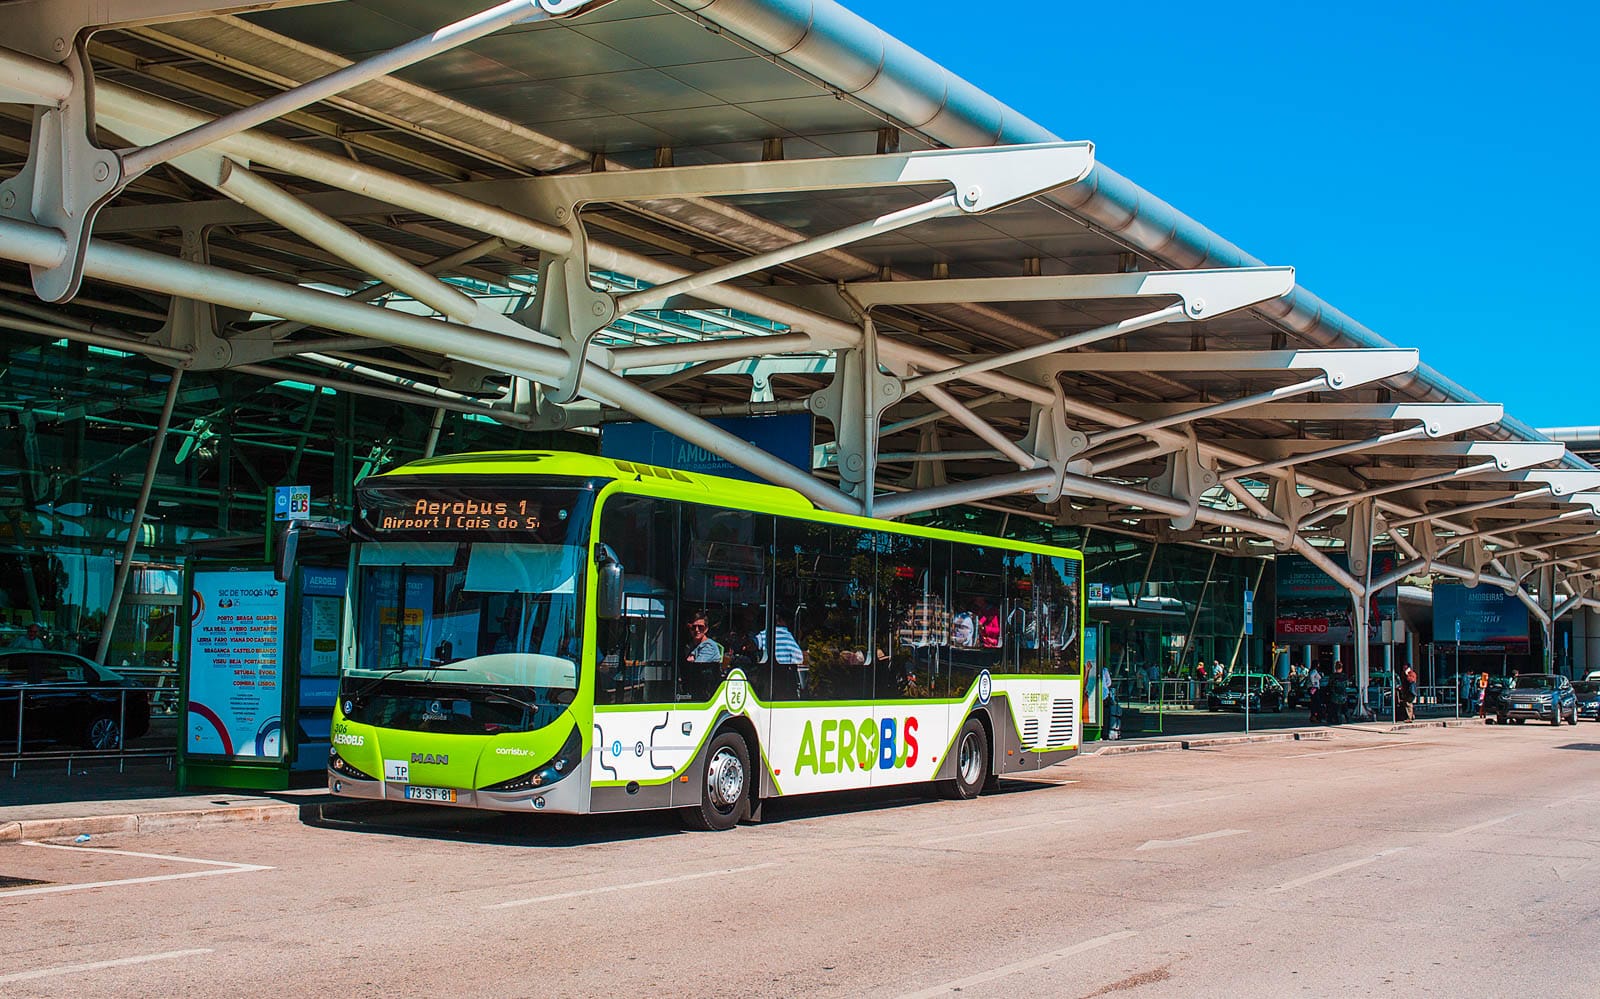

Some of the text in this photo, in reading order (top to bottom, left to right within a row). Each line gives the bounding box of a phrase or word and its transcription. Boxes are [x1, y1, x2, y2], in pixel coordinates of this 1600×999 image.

[291, 499, 309, 513] BUS
[415, 498, 528, 516] Aerobus 1
[383, 516, 439, 529] Airport
[456, 516, 491, 529] Cais
[497, 517, 519, 529] do
[218, 587, 279, 597] SIC DE TODOS NÓS
[1294, 624, 1327, 633] REFUND
[334, 723, 348, 734] 306
[334, 733, 364, 746] AEROBUS
[496, 747, 530, 756] carristur
[794, 716, 919, 776] AEROBUS
[411, 753, 449, 765] MAN
[395, 766, 408, 777] TP
